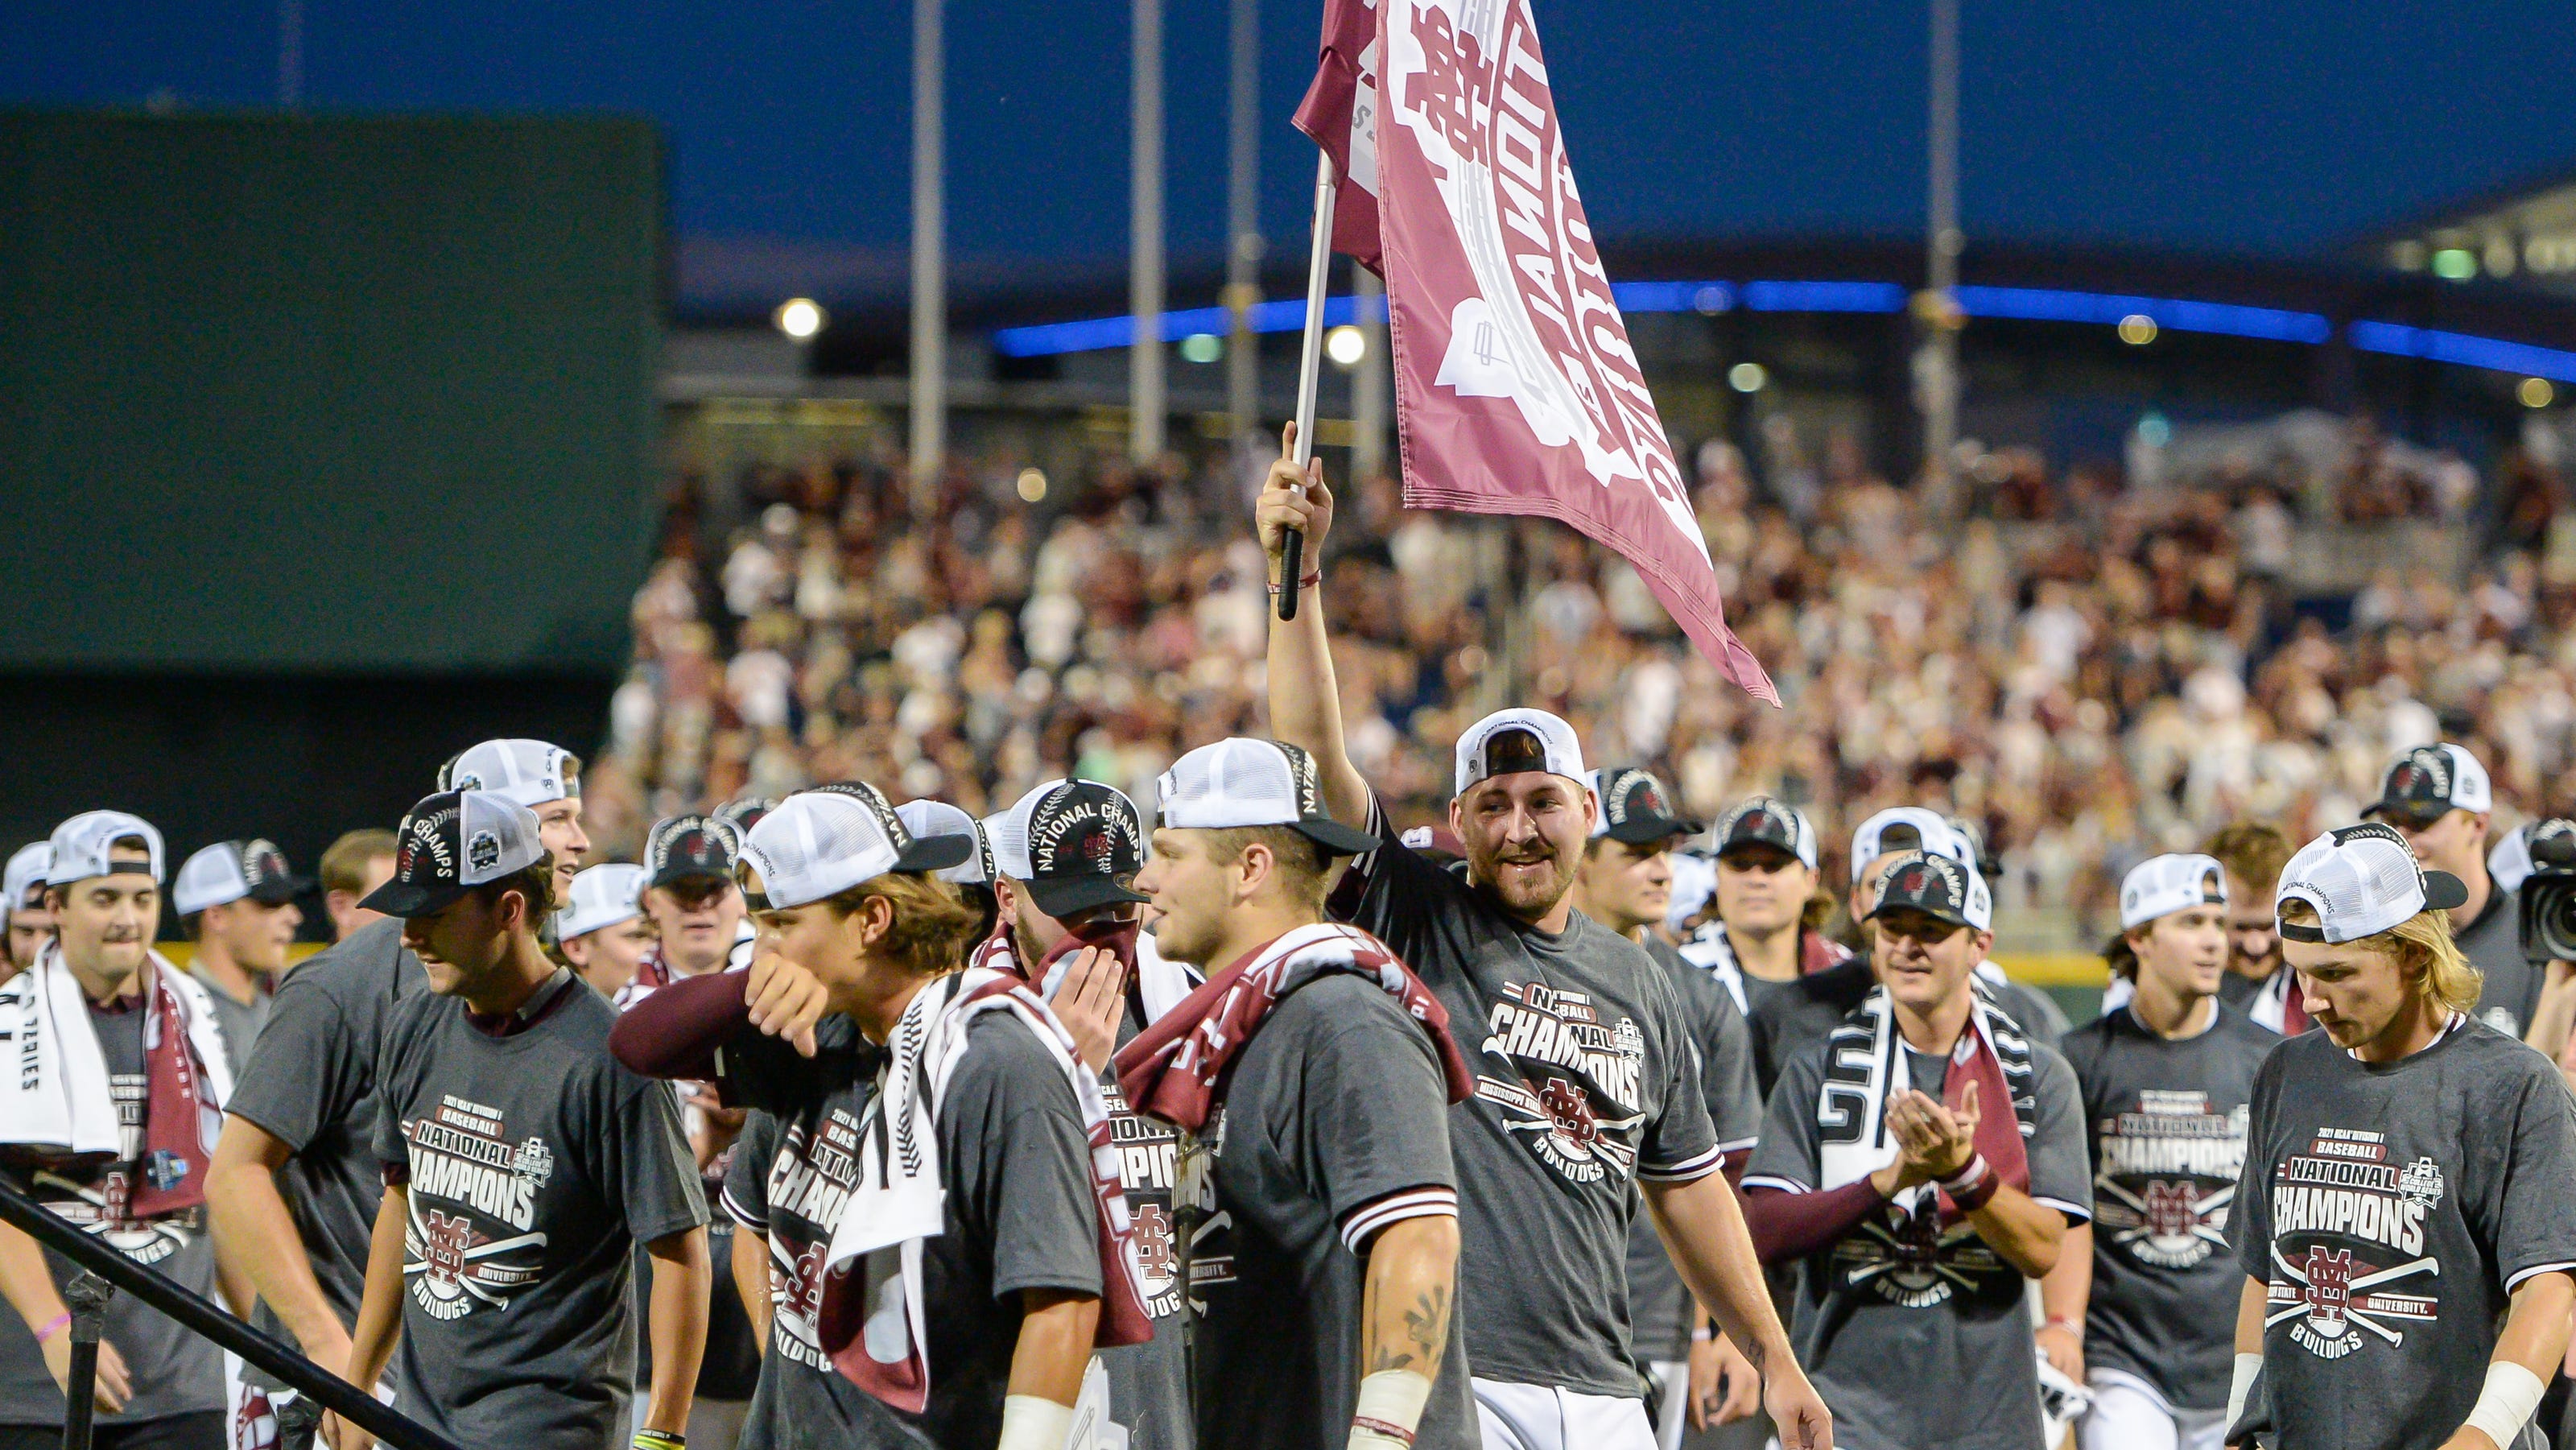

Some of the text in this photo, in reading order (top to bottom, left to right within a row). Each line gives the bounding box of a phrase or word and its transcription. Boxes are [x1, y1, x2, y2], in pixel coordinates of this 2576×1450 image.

[414, 820, 453, 878] CHAMPS
[1038, 803, 1097, 871] NATIONAL
[1100, 803, 1140, 861] CHAMPS
[2306, 882, 2335, 915] CHAMPIONS
[1479, 1081, 1524, 1106] MISSISSIPPI
[440, 1108, 497, 1137] BASEBALL
[415, 1123, 513, 1170] NATIONAL
[2316, 1141, 2378, 1159] BASEBALL
[408, 1146, 535, 1232] HAMPIONS
[2289, 1157, 2398, 1192] NATIONAL
[2274, 1185, 2425, 1258] CHAMPIONS
[412, 1278, 473, 1320] BULLDOGS
[2289, 1323, 2363, 1360] BULLDOGS
